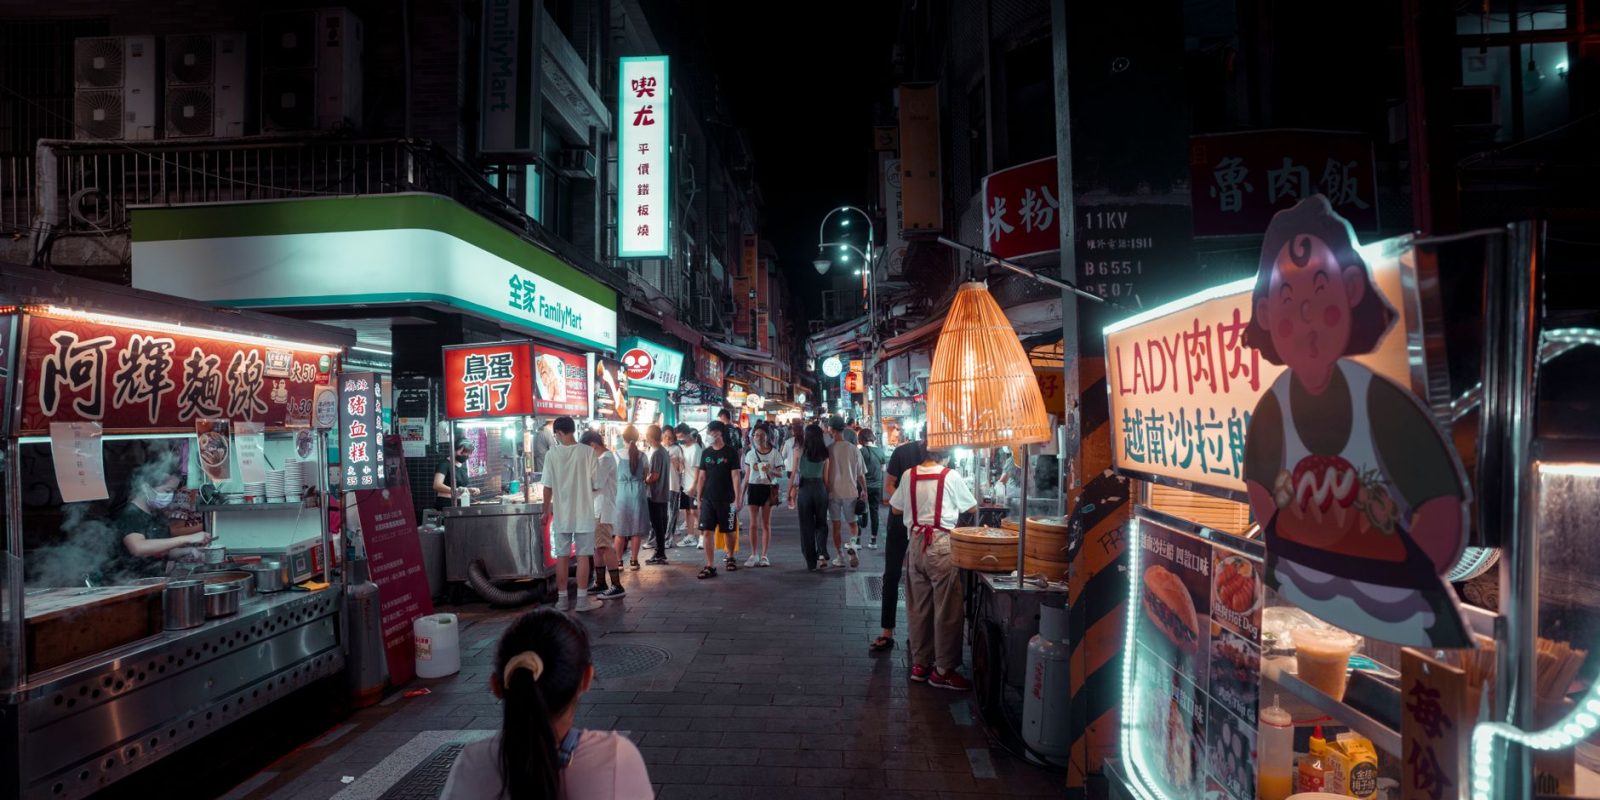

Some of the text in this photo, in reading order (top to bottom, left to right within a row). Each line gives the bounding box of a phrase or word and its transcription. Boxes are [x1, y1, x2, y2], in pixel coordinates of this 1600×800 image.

[491, 0, 514, 112] amilyMart
[631, 76, 657, 127] 喫尤
[637, 142, 650, 237] 平價鐵板燒
[1208, 155, 1371, 213] 魯肉飯
[1085, 211, 1128, 230] 11KV
[508, 274, 582, 330] 全家 FamilyMart
[39, 332, 268, 424] 阿輝麵線
[462, 352, 514, 384] 鳥蛋
[463, 383, 512, 413] 到了
[348, 395, 369, 463] 豬血糕
